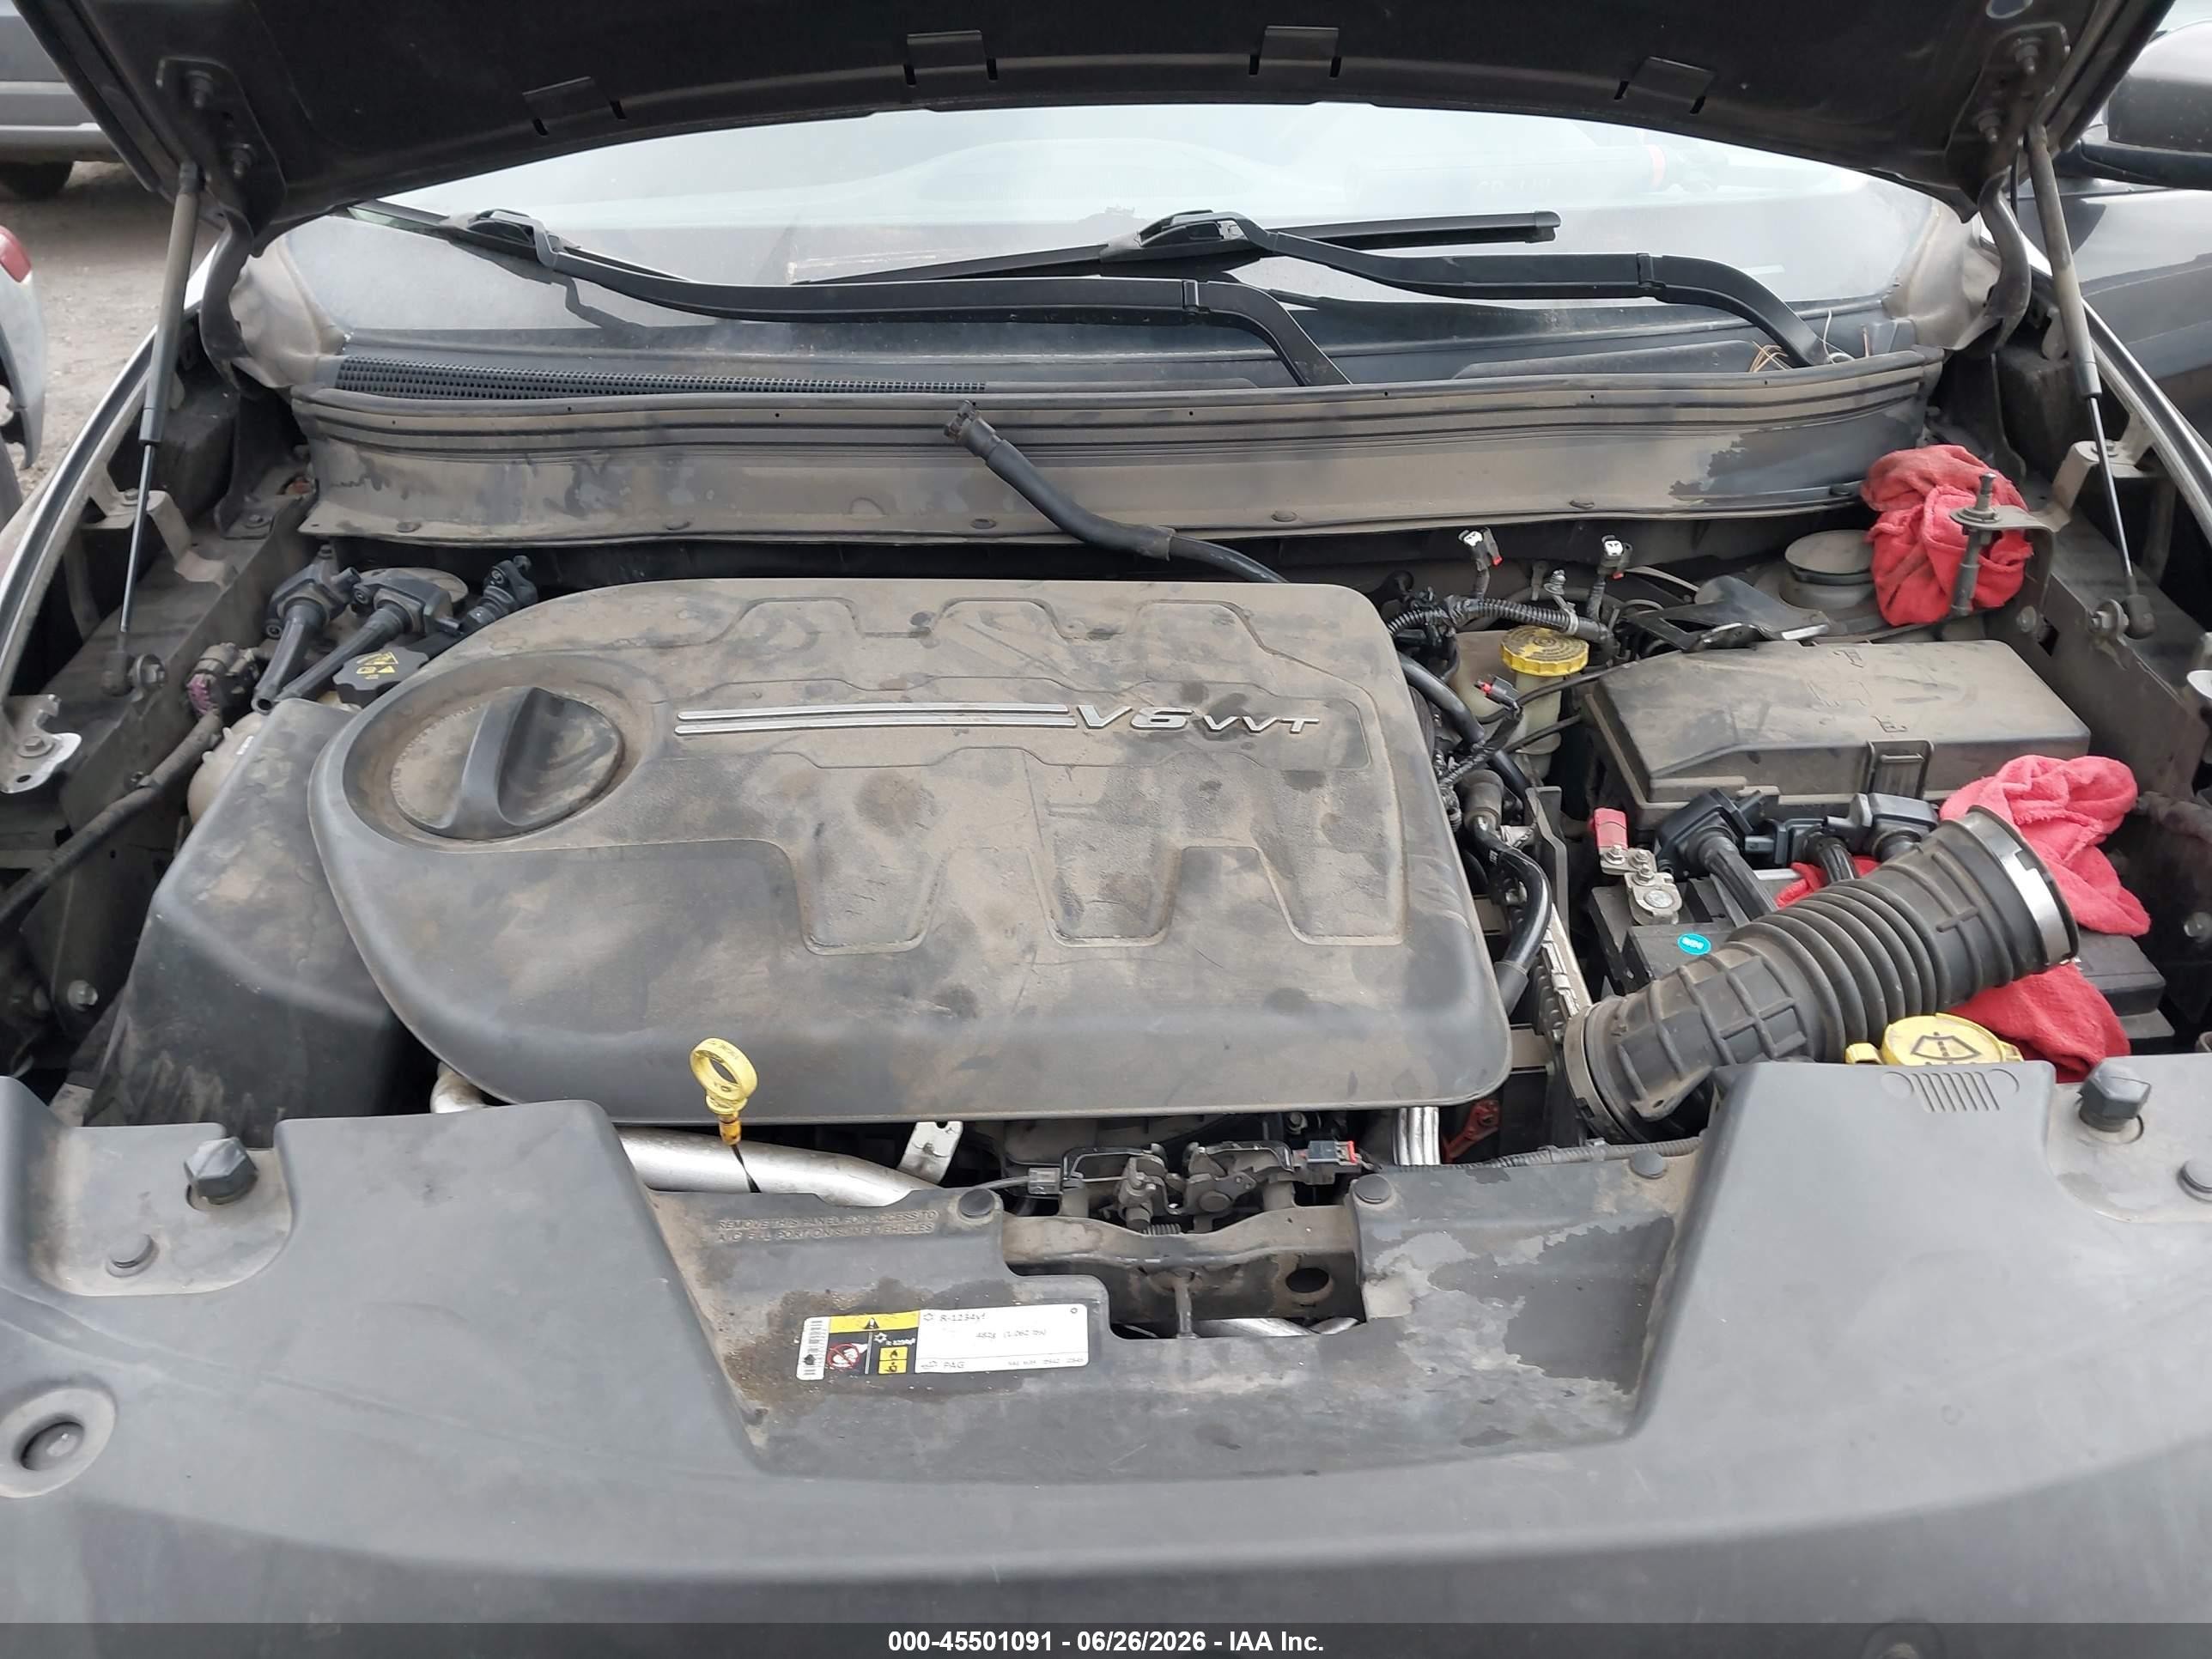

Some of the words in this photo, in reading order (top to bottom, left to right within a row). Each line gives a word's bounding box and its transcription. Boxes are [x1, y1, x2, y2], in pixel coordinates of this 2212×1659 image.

[1077, 705, 1194, 730] V6
[1203, 714, 1320, 734] VVT
[718, 1218, 770, 1230] REMOVE
[802, 1216, 841, 1228] PANEL
[842, 1215, 871, 1225] FOR
[921, 1209, 939, 1221] TO
[810, 1227, 833, 1238] ON
[875, 1222, 935, 1235] VEHICLES
